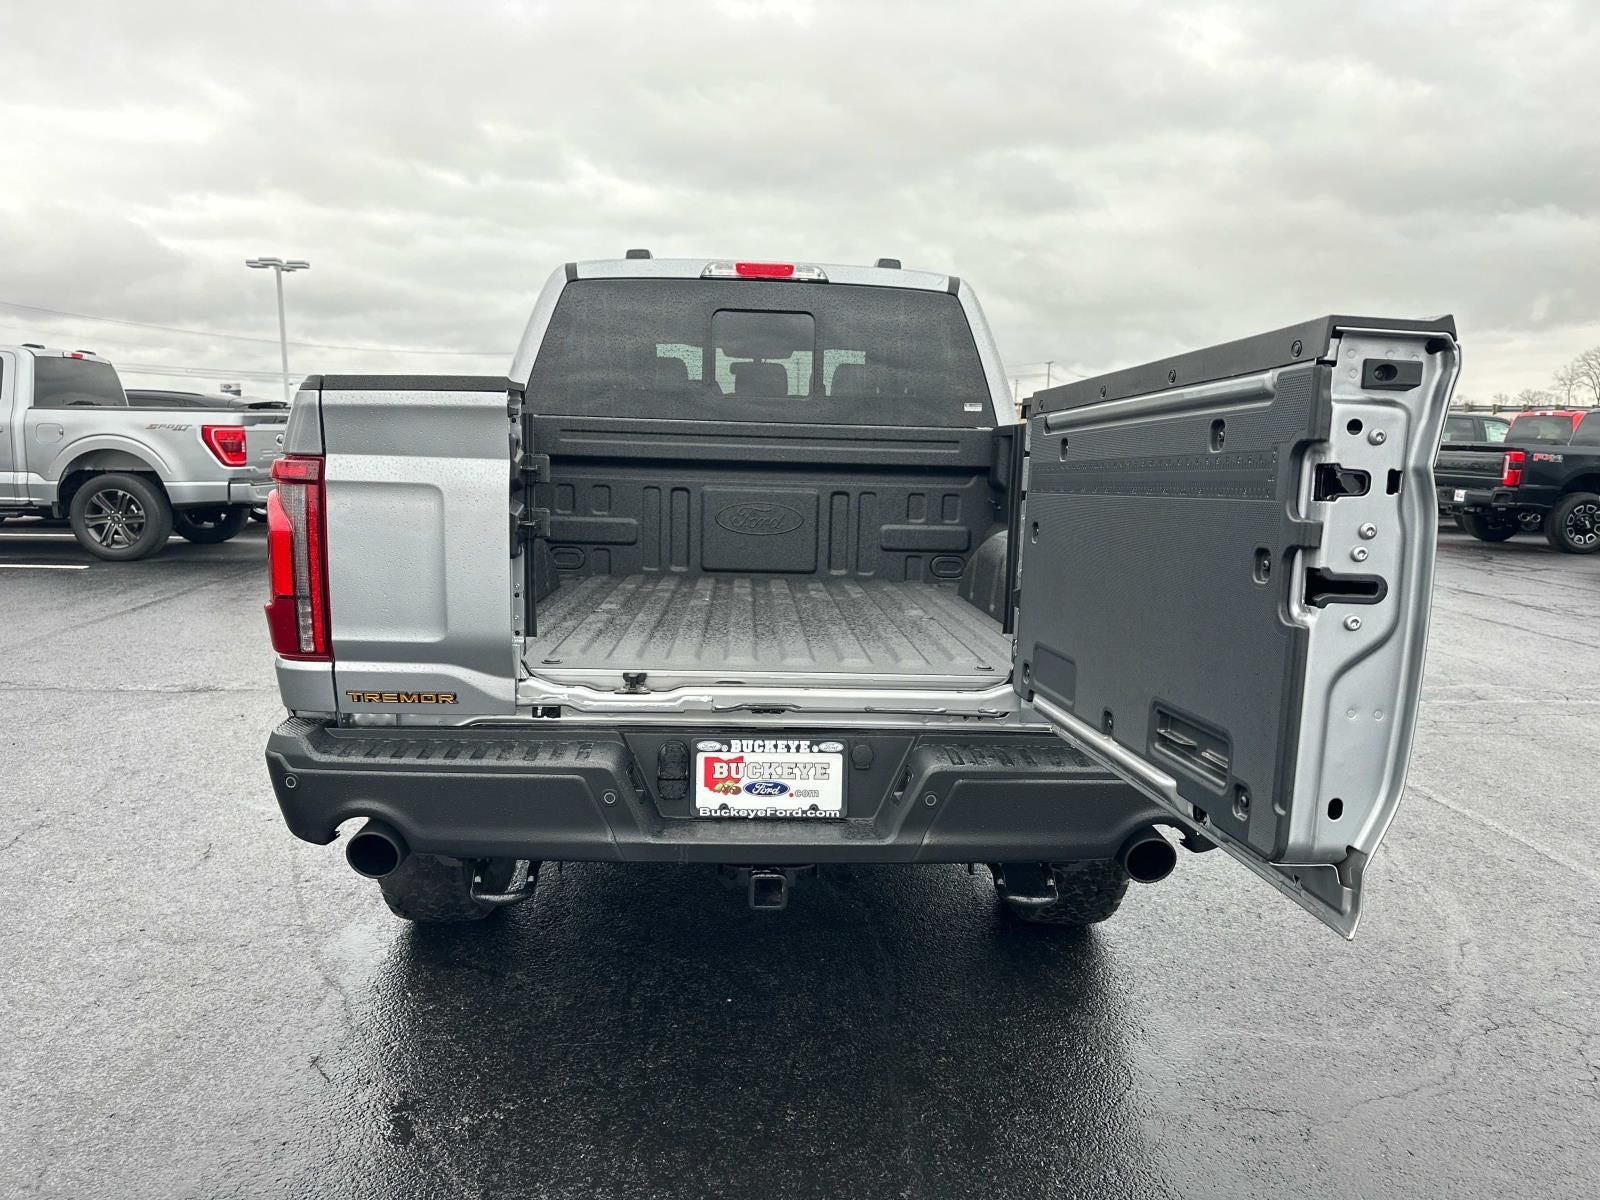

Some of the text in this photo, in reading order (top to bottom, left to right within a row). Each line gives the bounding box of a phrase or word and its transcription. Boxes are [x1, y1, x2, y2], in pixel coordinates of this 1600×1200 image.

[731, 507, 786, 529] Ford
[346, 691, 459, 705] TREMOR
[730, 740, 810, 753] BUCKEYE
[712, 762, 830, 780] BUCKEYE
[752, 783, 781, 795] Ford
[699, 807, 840, 818] BuckeyeFord.com
